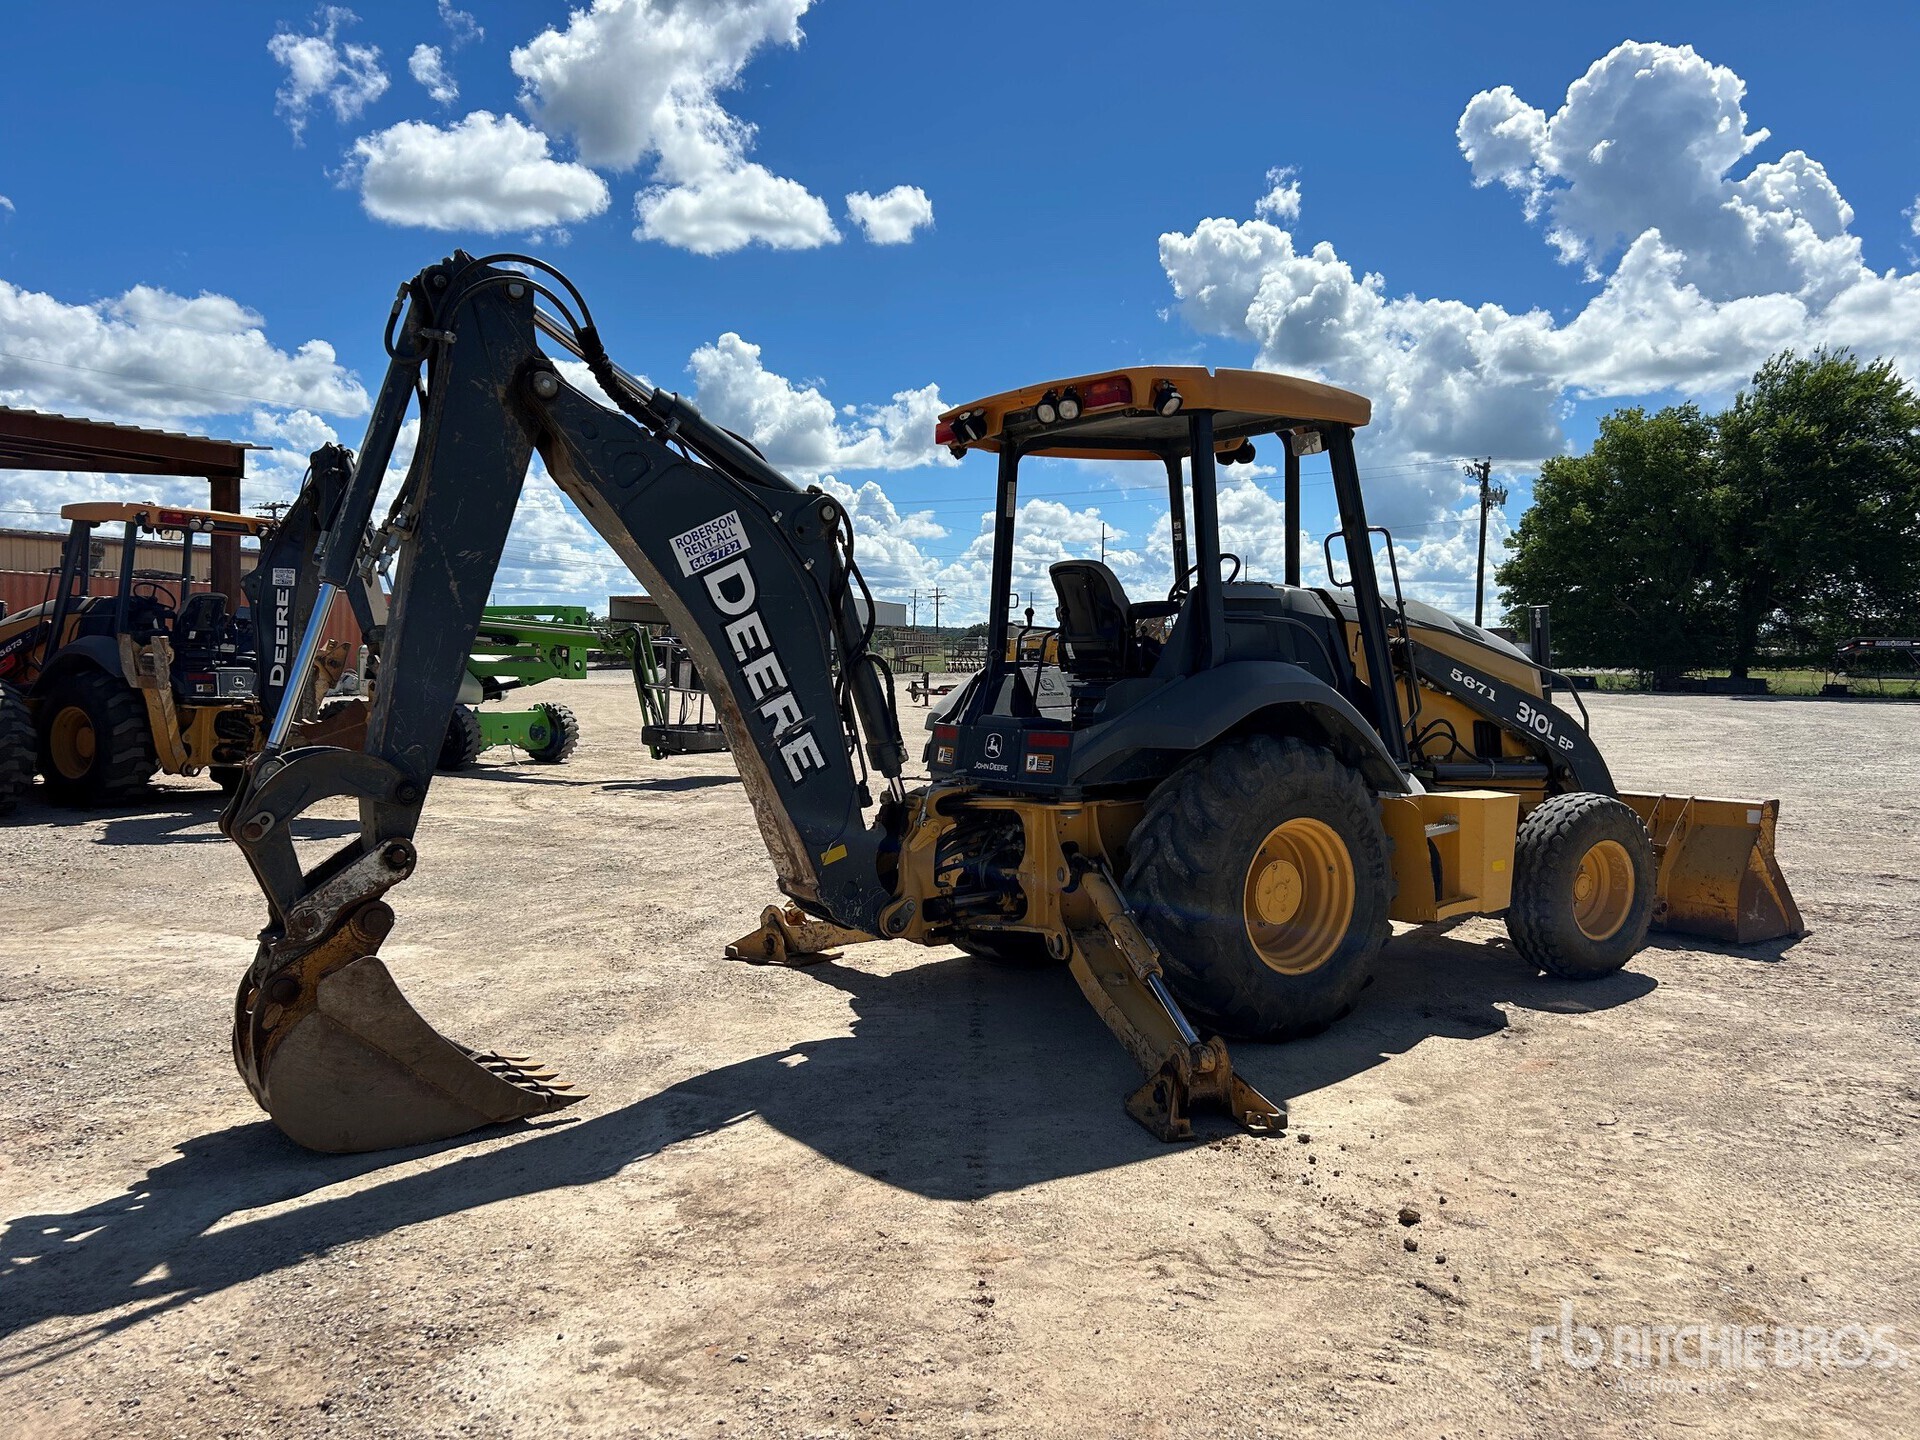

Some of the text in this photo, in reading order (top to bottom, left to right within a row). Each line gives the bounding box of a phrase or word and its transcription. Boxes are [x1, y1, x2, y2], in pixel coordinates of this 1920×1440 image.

[675, 513, 737, 549] ROBERSON
[683, 527, 738, 558] RENT-ALL
[691, 541, 740, 570] 646-7732
[269, 588, 290, 687] DEERE
[703, 557, 825, 783] DEERE
[1450, 667, 1497, 703] 5671
[1516, 701, 1574, 751] 310L EP
[973, 761, 1009, 772] JOHN DEERE
